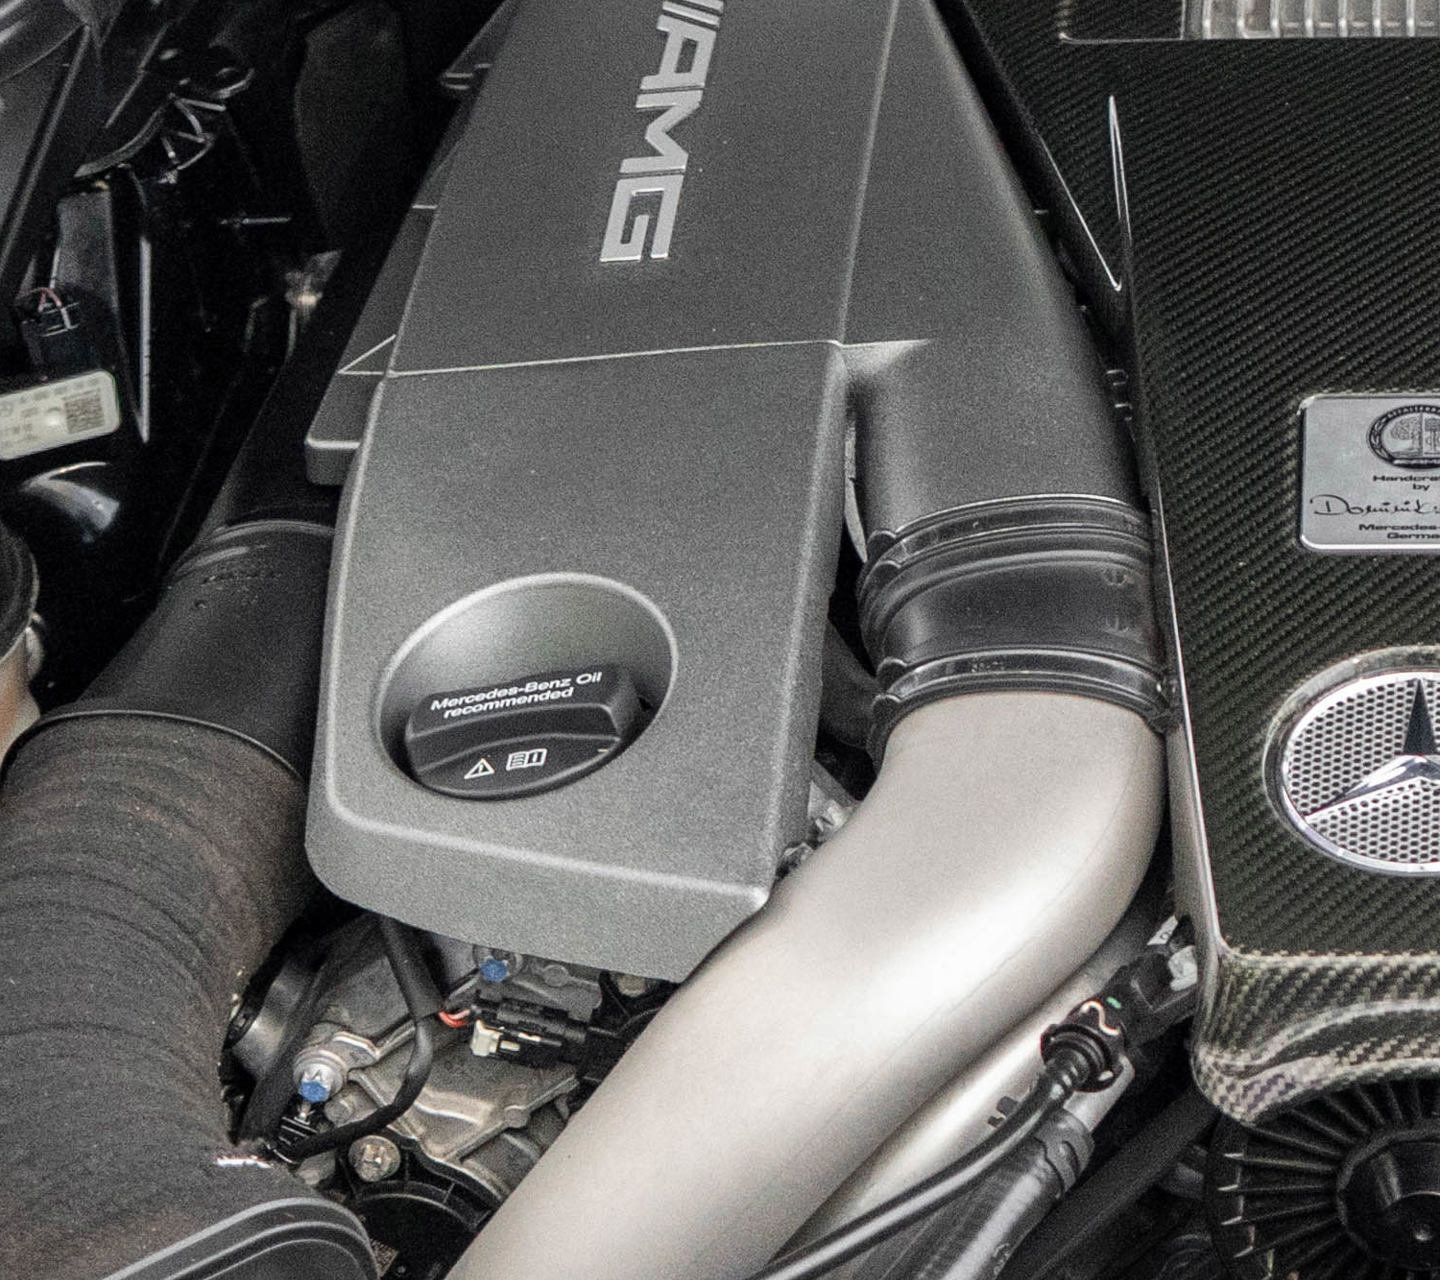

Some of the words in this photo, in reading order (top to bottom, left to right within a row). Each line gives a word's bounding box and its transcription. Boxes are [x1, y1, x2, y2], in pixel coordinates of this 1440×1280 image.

[600, 14, 719, 263] AMG
[1412, 483, 1431, 492] by
[430, 677, 572, 711] Mercedes-Benz
[575, 671, 603, 685] Oil
[443, 686, 575, 720] recommended
